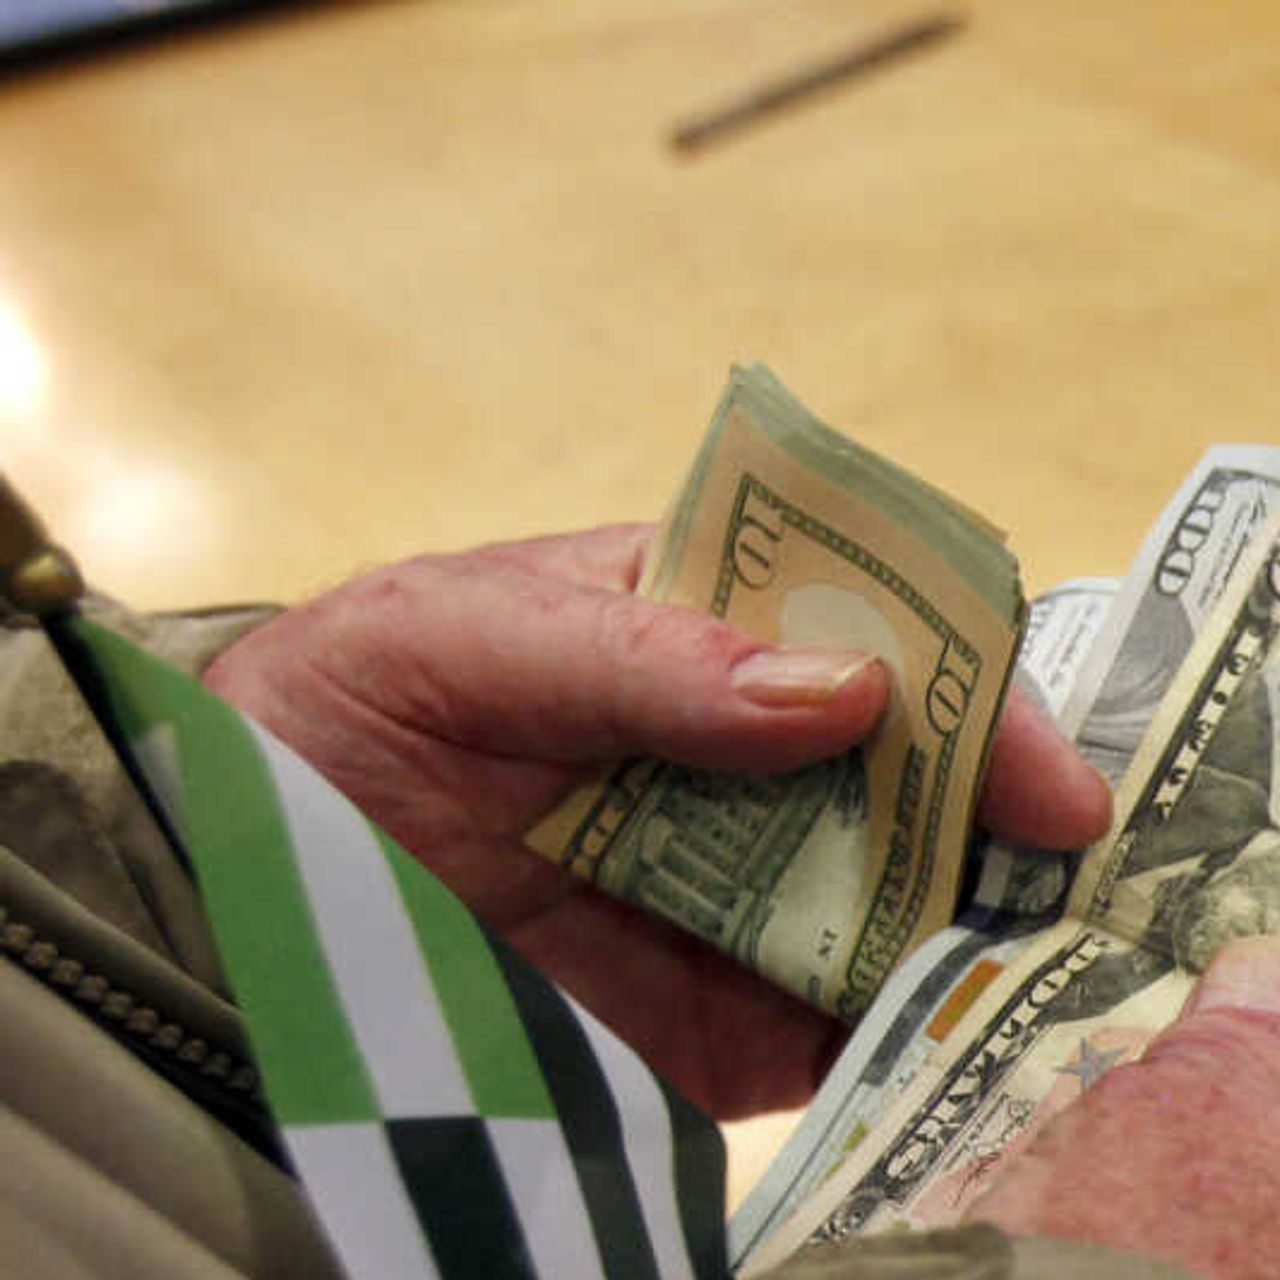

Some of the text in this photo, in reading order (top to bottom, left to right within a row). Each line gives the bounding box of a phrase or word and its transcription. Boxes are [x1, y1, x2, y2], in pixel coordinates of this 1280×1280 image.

[733, 492, 784, 590] 10
[1155, 486, 1228, 597] 100
[926, 640, 980, 737] 10
[1152, 628, 1260, 821] FIFTY
[887, 936, 1104, 1183] DOLLARS
